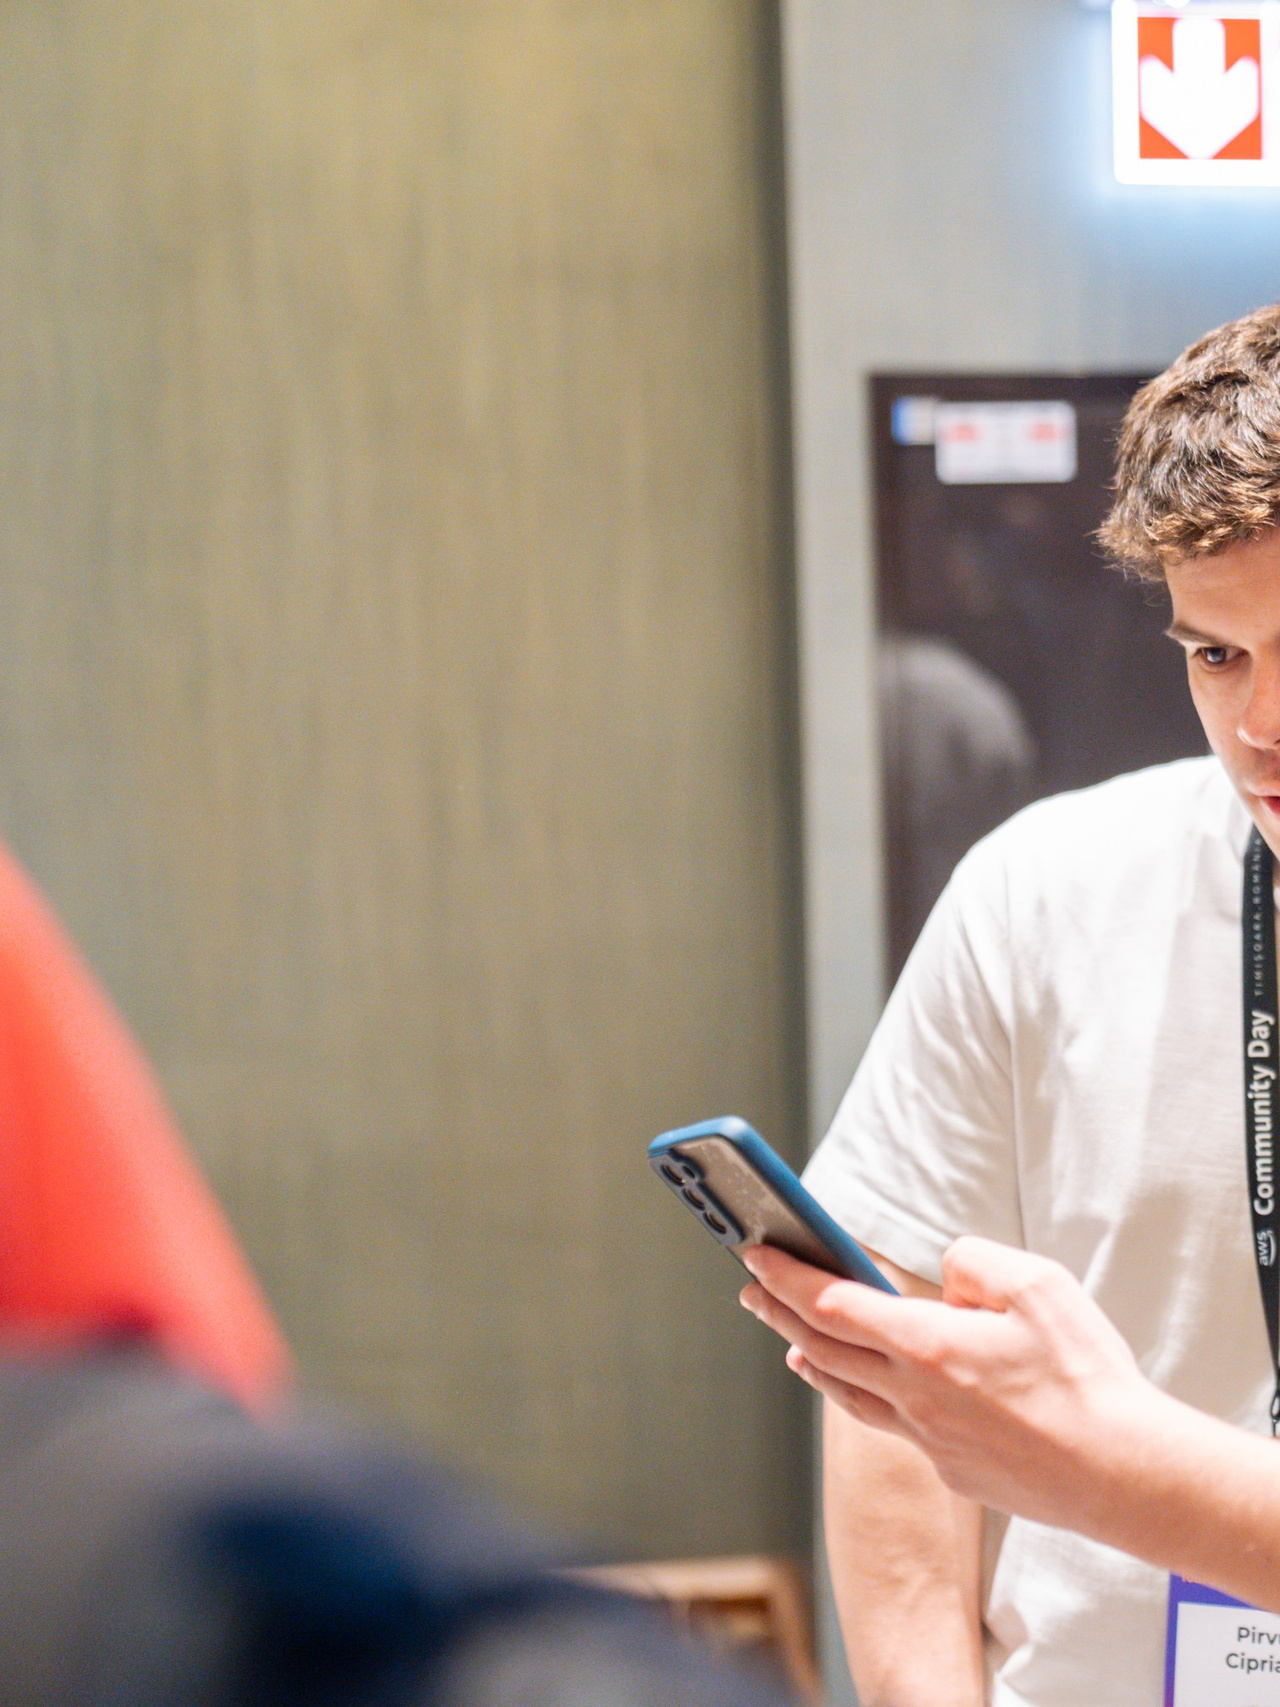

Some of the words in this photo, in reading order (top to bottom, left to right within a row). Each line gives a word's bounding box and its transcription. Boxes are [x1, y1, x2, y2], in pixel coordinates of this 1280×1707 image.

[1248, 1010, 1276, 1058] Day
[1246, 1064, 1277, 1215] Community
[1256, 1229, 1271, 1267] aws
